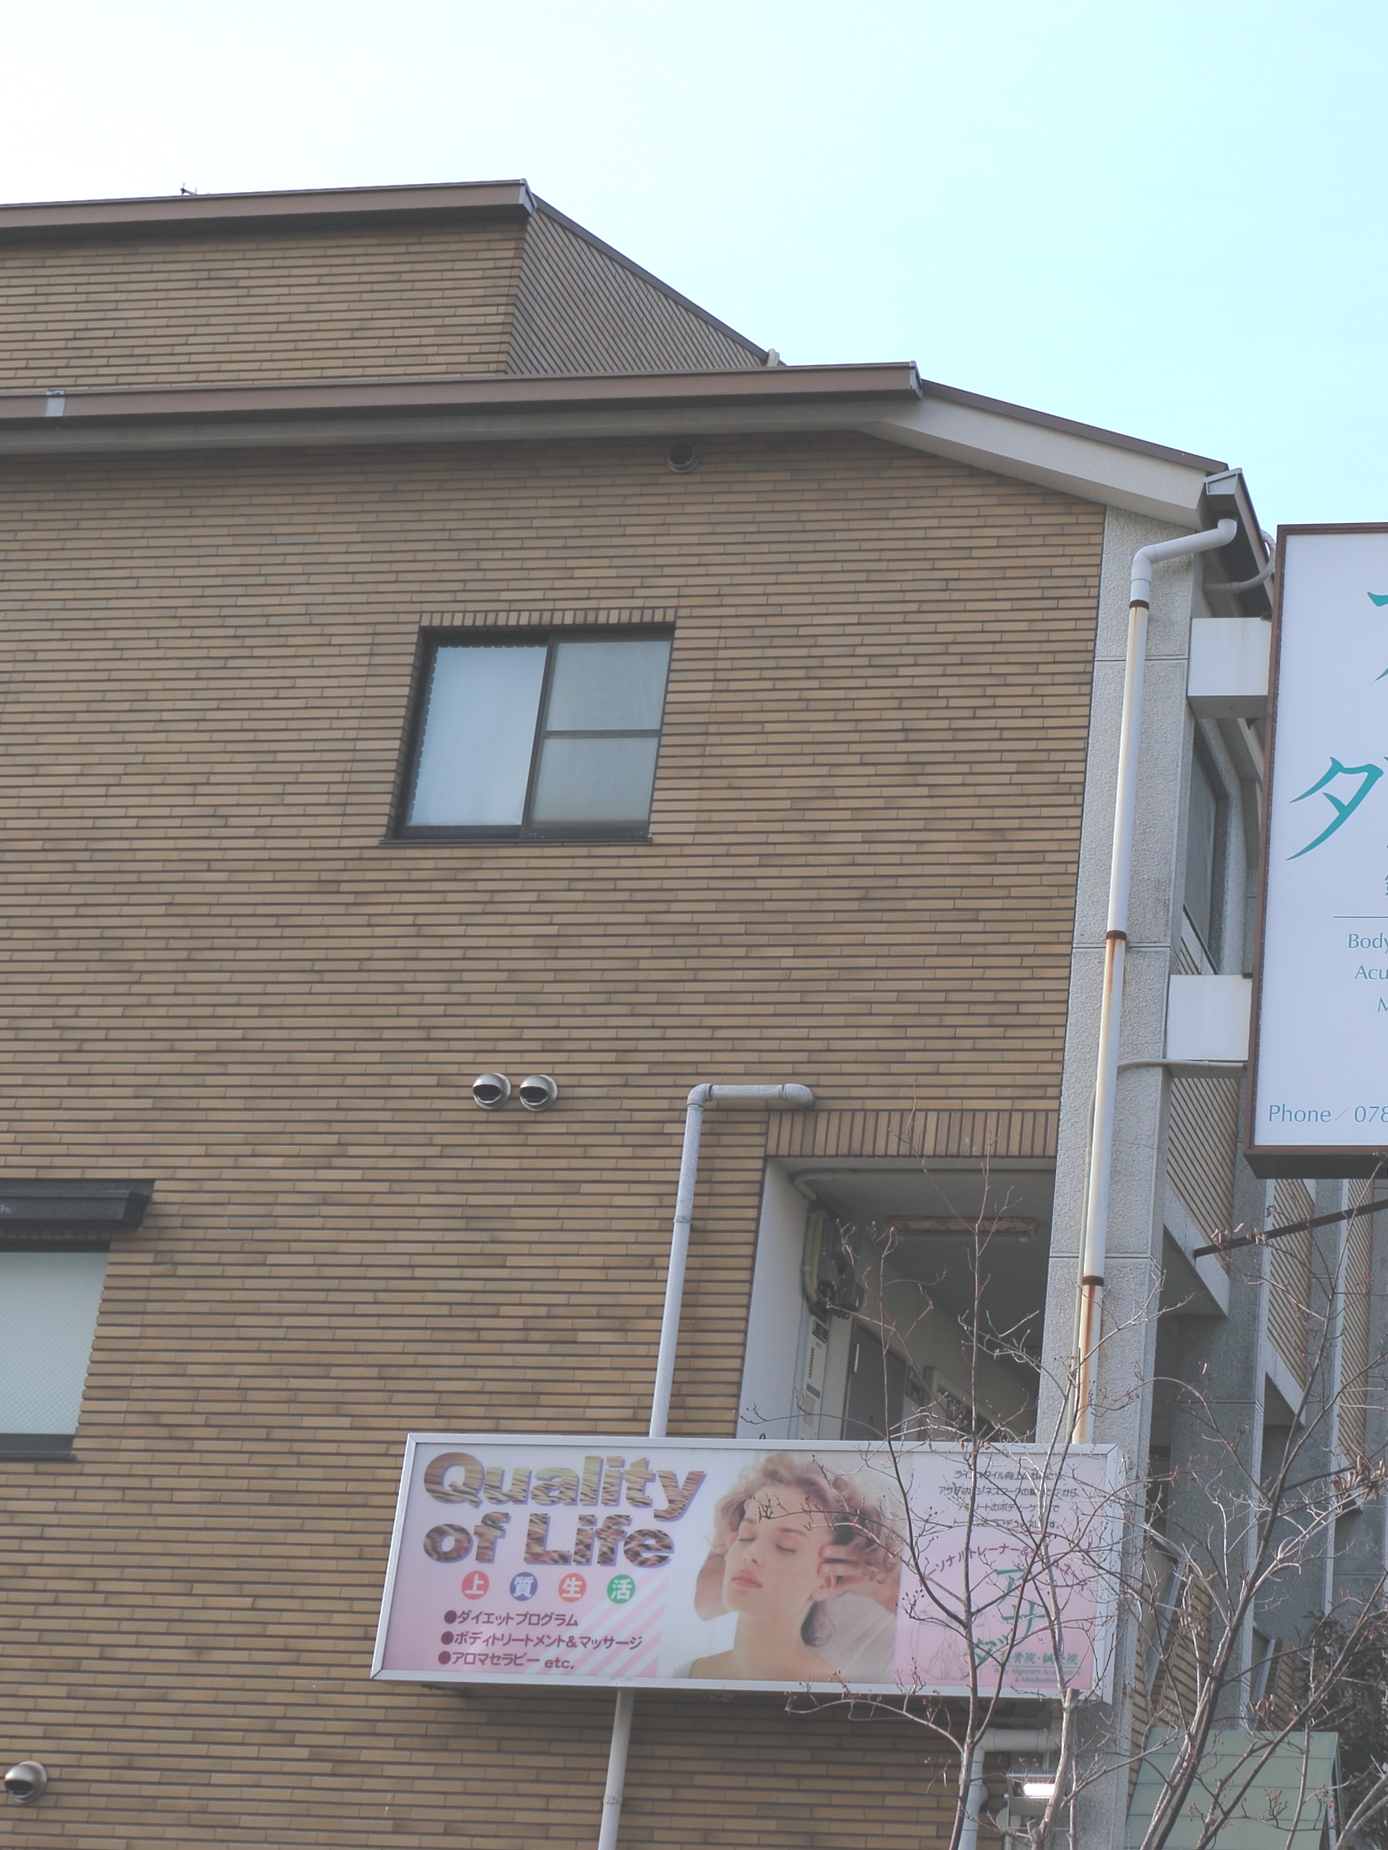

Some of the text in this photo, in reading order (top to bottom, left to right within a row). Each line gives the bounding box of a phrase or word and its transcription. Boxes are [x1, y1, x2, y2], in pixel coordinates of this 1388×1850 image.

[423, 1451, 707, 1522] Quality
[422, 1510, 675, 1569] of Life
[457, 1609, 579, 1627] ダイエットプログラム
[453, 1630, 643, 1651] ボディトリートメント&マッサージ
[451, 1651, 575, 1670] アロマセラピー etc.
